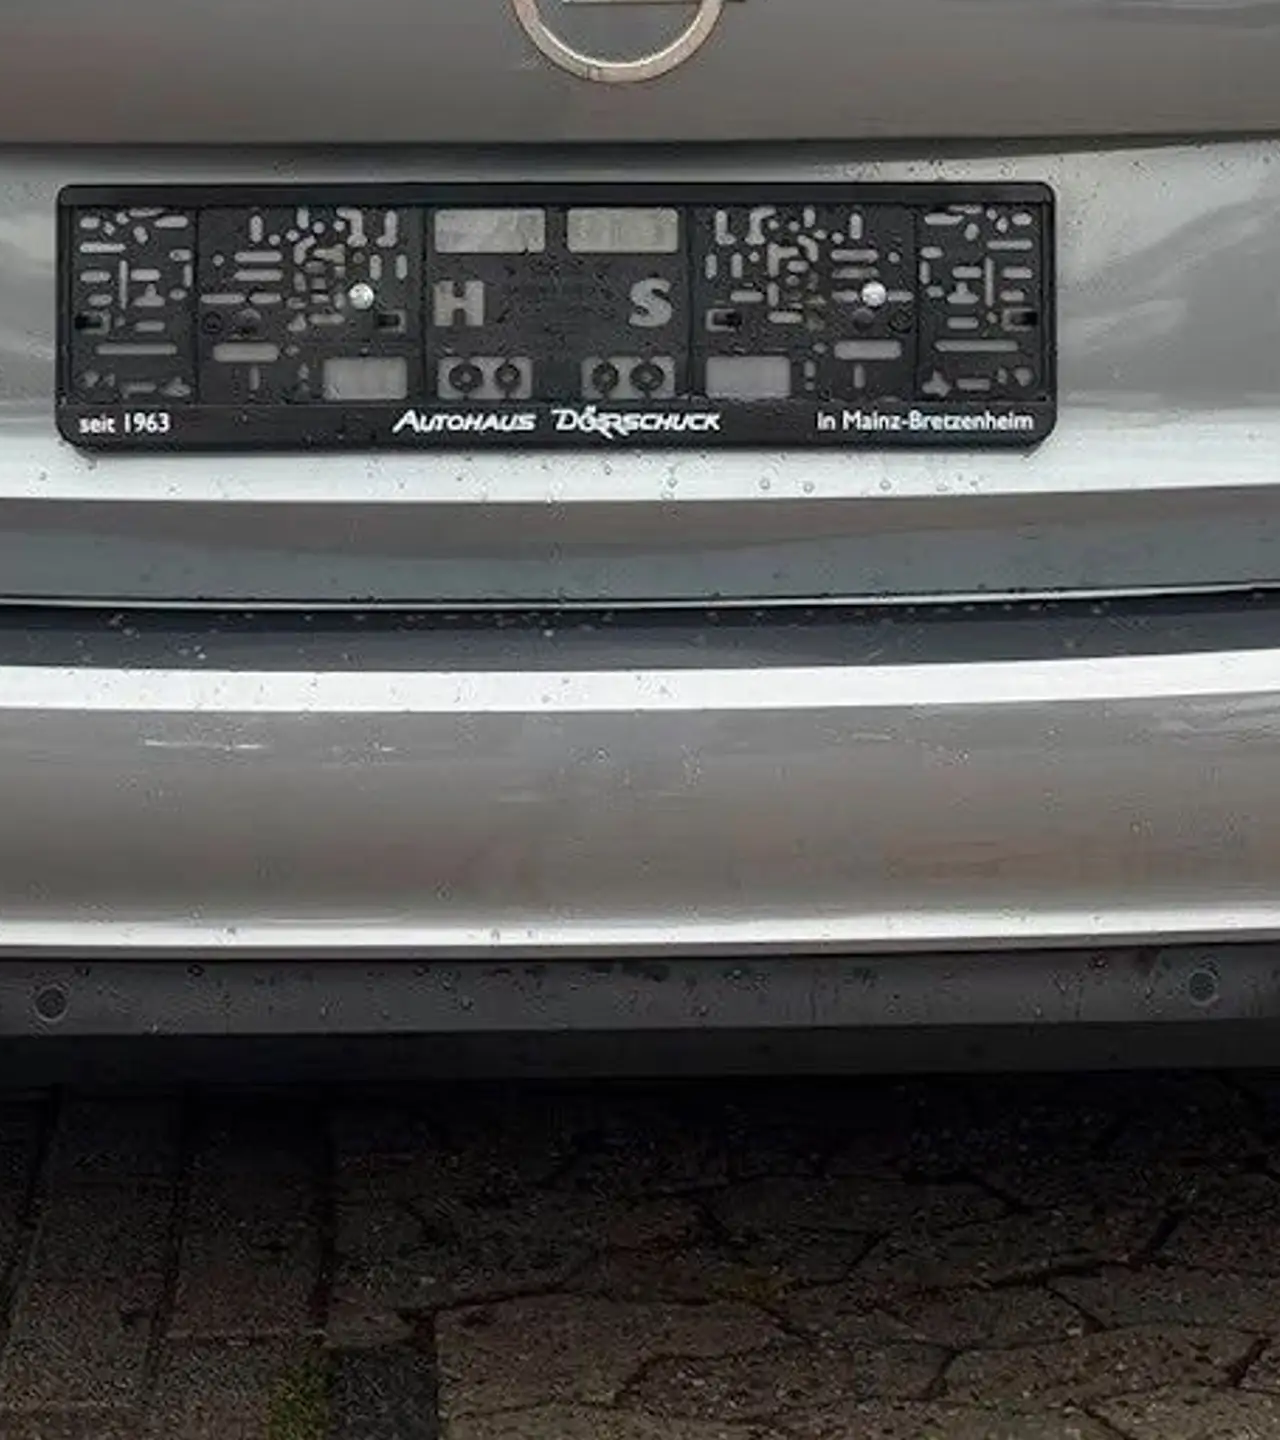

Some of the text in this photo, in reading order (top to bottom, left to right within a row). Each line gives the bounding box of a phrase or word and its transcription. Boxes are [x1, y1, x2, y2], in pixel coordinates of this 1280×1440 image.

[79, 412, 170, 434] seit 1963
[816, 409, 1034, 431] in Mainz-Bretzenheim
